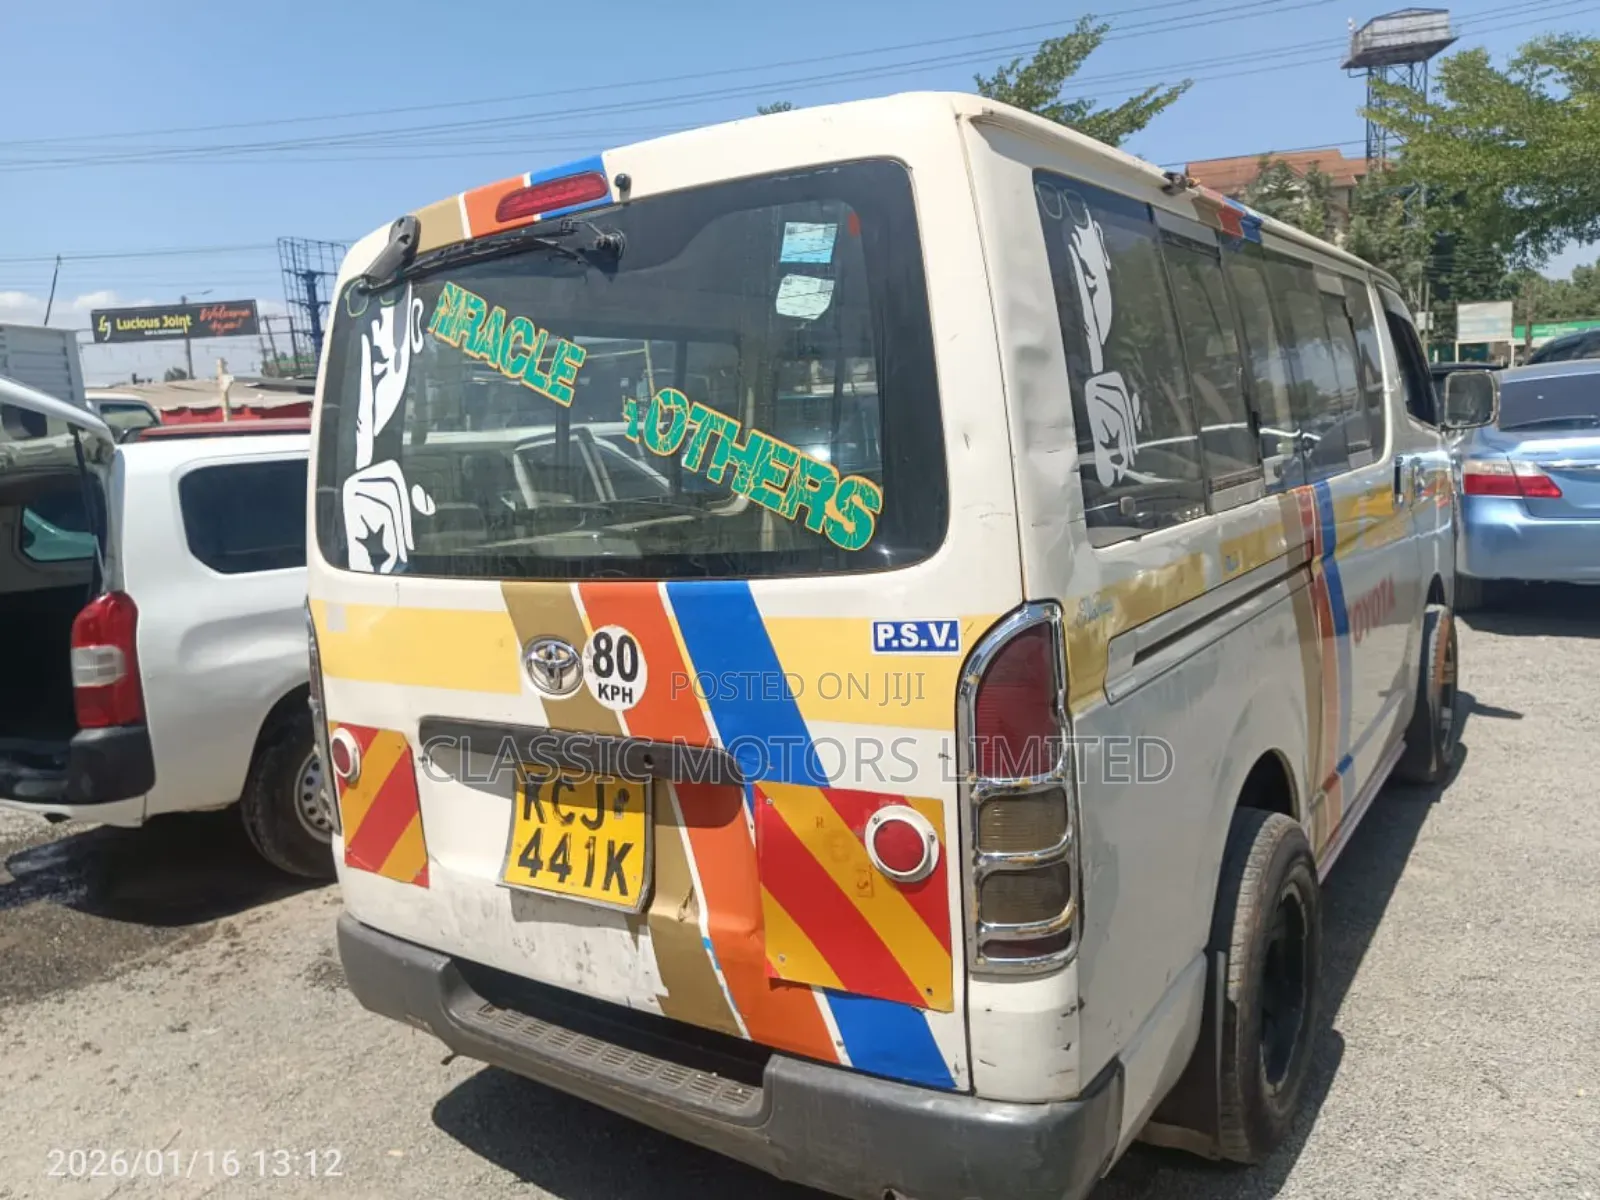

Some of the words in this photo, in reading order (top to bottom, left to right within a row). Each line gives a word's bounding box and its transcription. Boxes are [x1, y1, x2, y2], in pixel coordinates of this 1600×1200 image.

[116, 316, 161, 331] Lucious
[162, 313, 193, 334] Joint
[621, 387, 884, 551] OTHERS
[592, 631, 639, 682] 80
[877, 622, 957, 648] P.S.V.
[598, 682, 633, 704] KPH
[523, 771, 606, 831] KCJ
[517, 827, 634, 897] 441K
